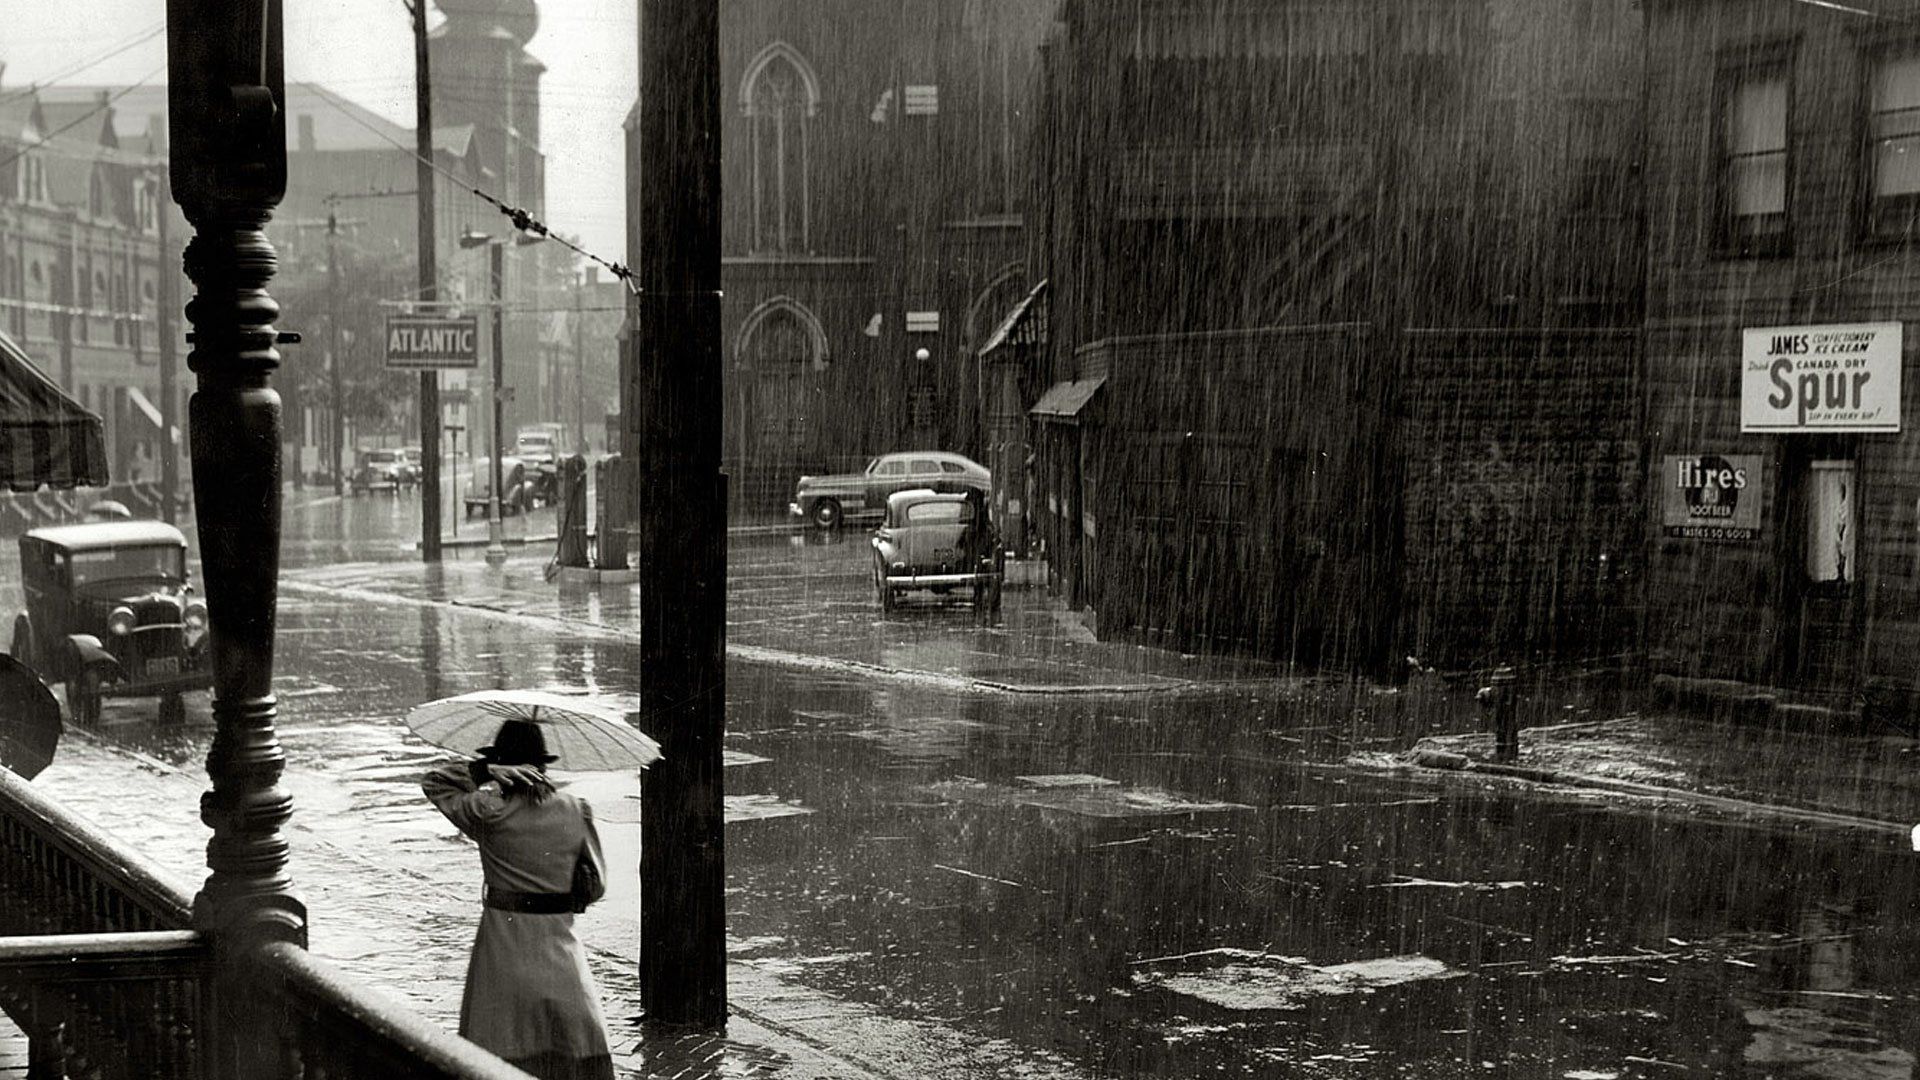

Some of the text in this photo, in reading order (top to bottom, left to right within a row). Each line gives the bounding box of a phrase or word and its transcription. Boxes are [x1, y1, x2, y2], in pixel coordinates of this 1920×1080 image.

[389, 328, 473, 352] ATLANTIC
[1812, 332, 1876, 343] CONFECTIONERY
[1767, 334, 1809, 355] JAMES
[1815, 343, 1869, 354] ICE CREAM
[1796, 359, 1868, 369] CANADA DRY
[1768, 357, 1871, 426] Spur
[1834, 412, 1859, 420] EVERY
[1677, 459, 1746, 489] Hires
[1726, 528, 1751, 539] GOOD
